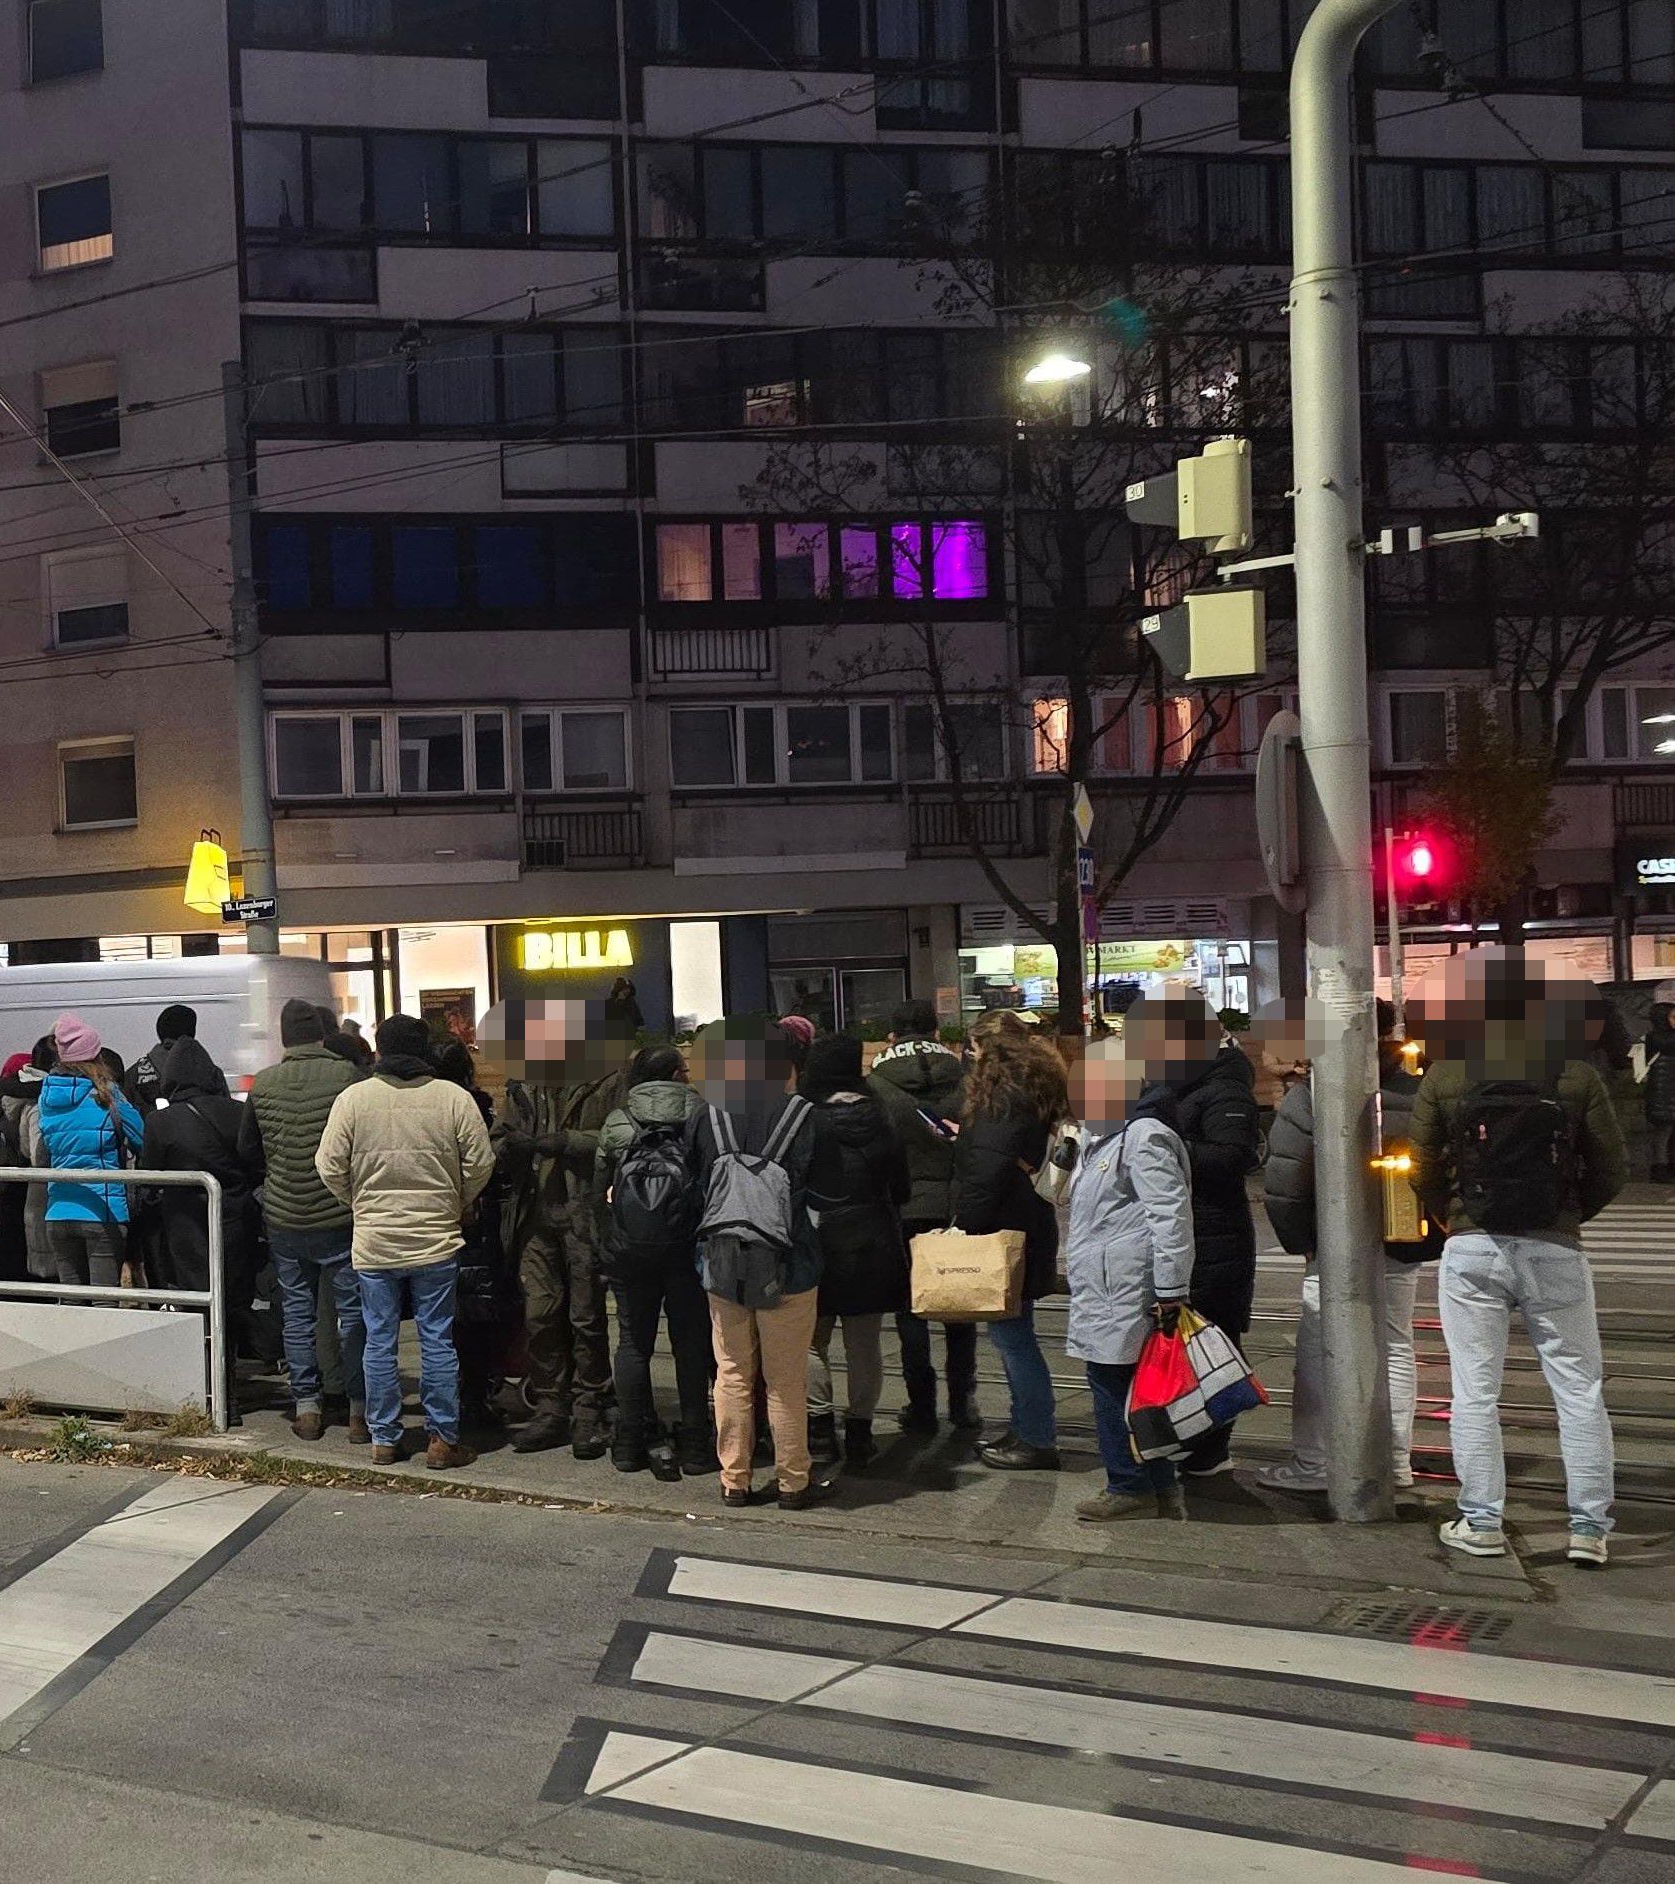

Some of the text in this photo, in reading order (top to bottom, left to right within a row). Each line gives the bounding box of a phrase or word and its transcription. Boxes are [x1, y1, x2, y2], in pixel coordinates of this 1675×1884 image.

[1127, 485, 1143, 500] 30
[1143, 617, 1159, 633] 29
[518, 929, 634, 970] BILLA
